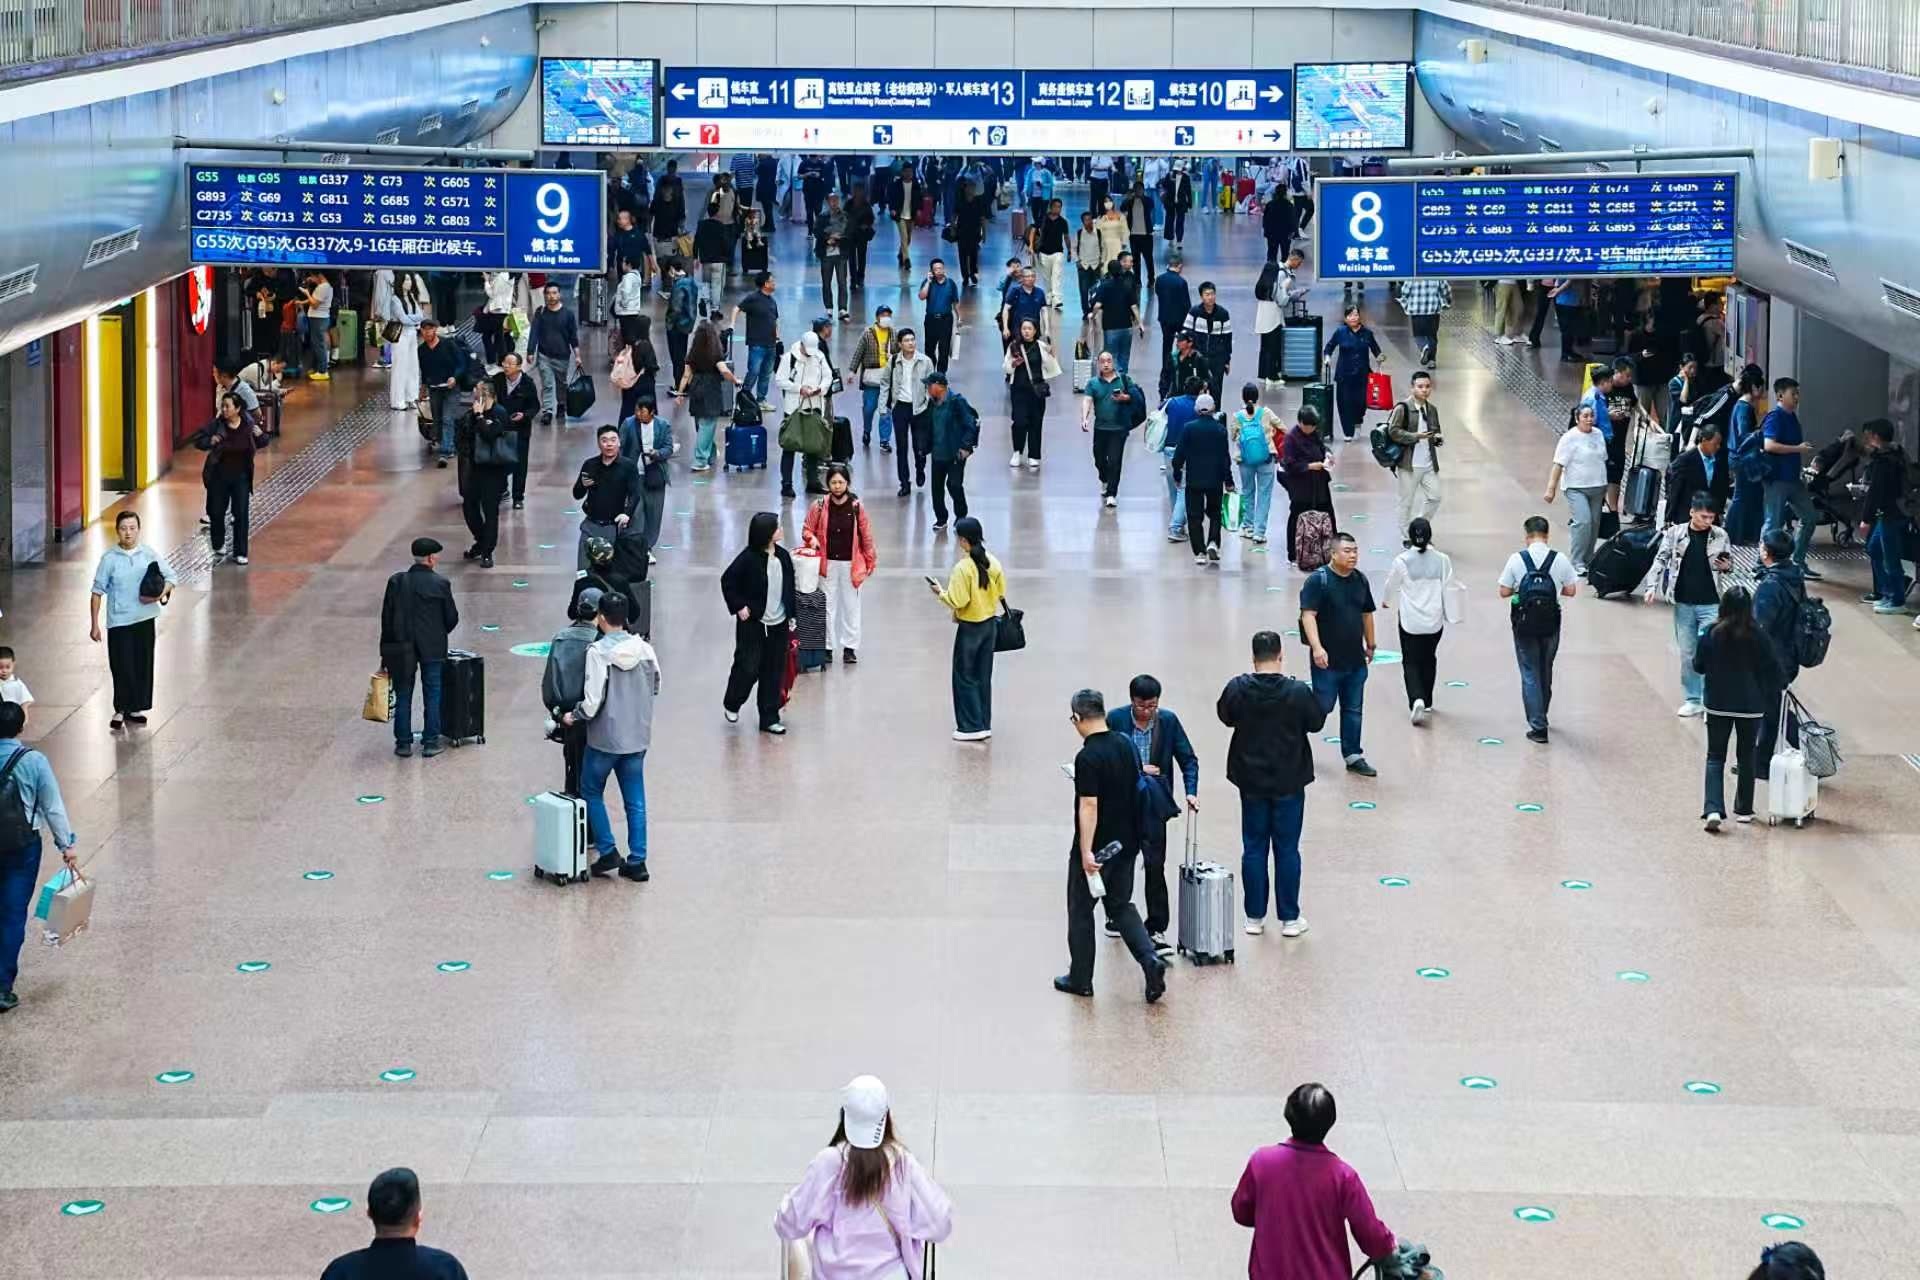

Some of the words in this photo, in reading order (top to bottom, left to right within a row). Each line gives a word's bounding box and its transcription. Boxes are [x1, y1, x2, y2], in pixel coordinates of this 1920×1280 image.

[731, 81, 759, 94] 候车室
[769, 80, 789, 104] 11
[990, 82, 1014, 105] 13
[1096, 82, 1120, 106] 12
[1169, 82, 1197, 96] 候车室
[1199, 82, 1223, 106] 10
[196, 172, 218, 182] G55
[258, 173, 280, 183] G95
[320, 174, 348, 185] G337
[363, 175, 375, 186] 次
[380, 176, 402, 186] G73
[424, 176, 435, 187] 次
[442, 177, 470, 187] G605
[485, 177, 496, 188] 次
[197, 191, 226, 201] G893
[241, 191, 253, 202] 次
[258, 193, 281, 203] G69
[303, 192, 313, 203] 次
[320, 194, 348, 204] G811
[364, 194, 375, 205] 次
[381, 195, 409, 206] G685
[424, 195, 435, 206] 次
[441, 197, 470, 207] G571
[485, 196, 496, 207] 次
[536, 182, 570, 234] 9
[197, 210, 232, 221] C2735
[241, 210, 253, 221] 次
[258, 211, 294, 222] G6713
[303, 211, 314, 222] 次
[320, 213, 341, 223] G53
[364, 213, 375, 224] 次
[381, 215, 416, 224] G1589
[424, 214, 435, 225] 次
[441, 216, 469, 226] G803
[485, 216, 496, 226] 次
[1349, 191, 1384, 242] 8
[531, 238, 574, 252] 候车室
[524, 255, 556, 264] Waiting
[558, 255, 580, 263] Room
[1345, 247, 1389, 260] 候车室
[1338, 263, 1371, 273] Waiting
[1373, 263, 1395, 272] Room
